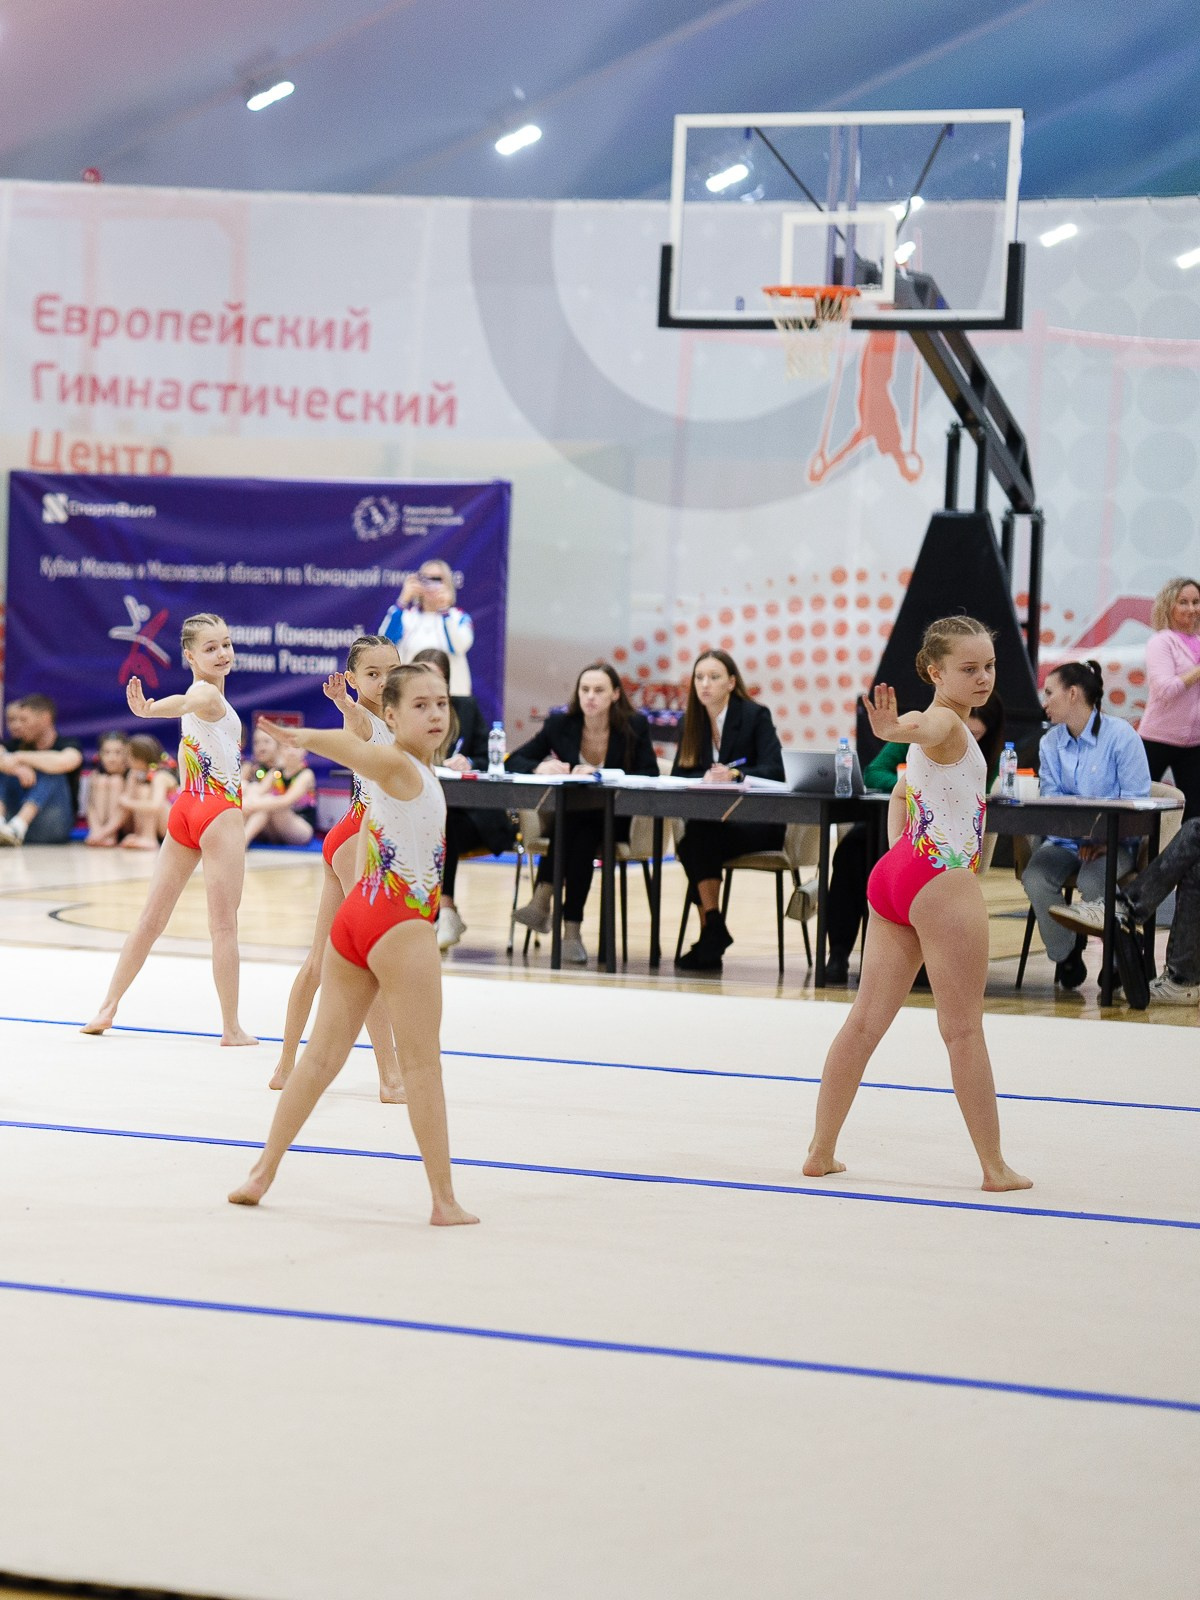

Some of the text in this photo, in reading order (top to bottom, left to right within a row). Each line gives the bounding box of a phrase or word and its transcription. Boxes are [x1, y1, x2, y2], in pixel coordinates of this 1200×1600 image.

[32, 292, 372, 353] Европейский
[31, 361, 459, 428] Гимнастический
[28, 429, 174, 476] Центр
[40, 555, 78, 581] Кубок
[81, 556, 134, 580] Москвы
[136, 563, 146, 580] и
[147, 558, 227, 583] Московской
[228, 561, 282, 585] области
[284, 566, 303, 585] по
[303, 562, 381, 588] Командной
[278, 648, 338, 675] России
